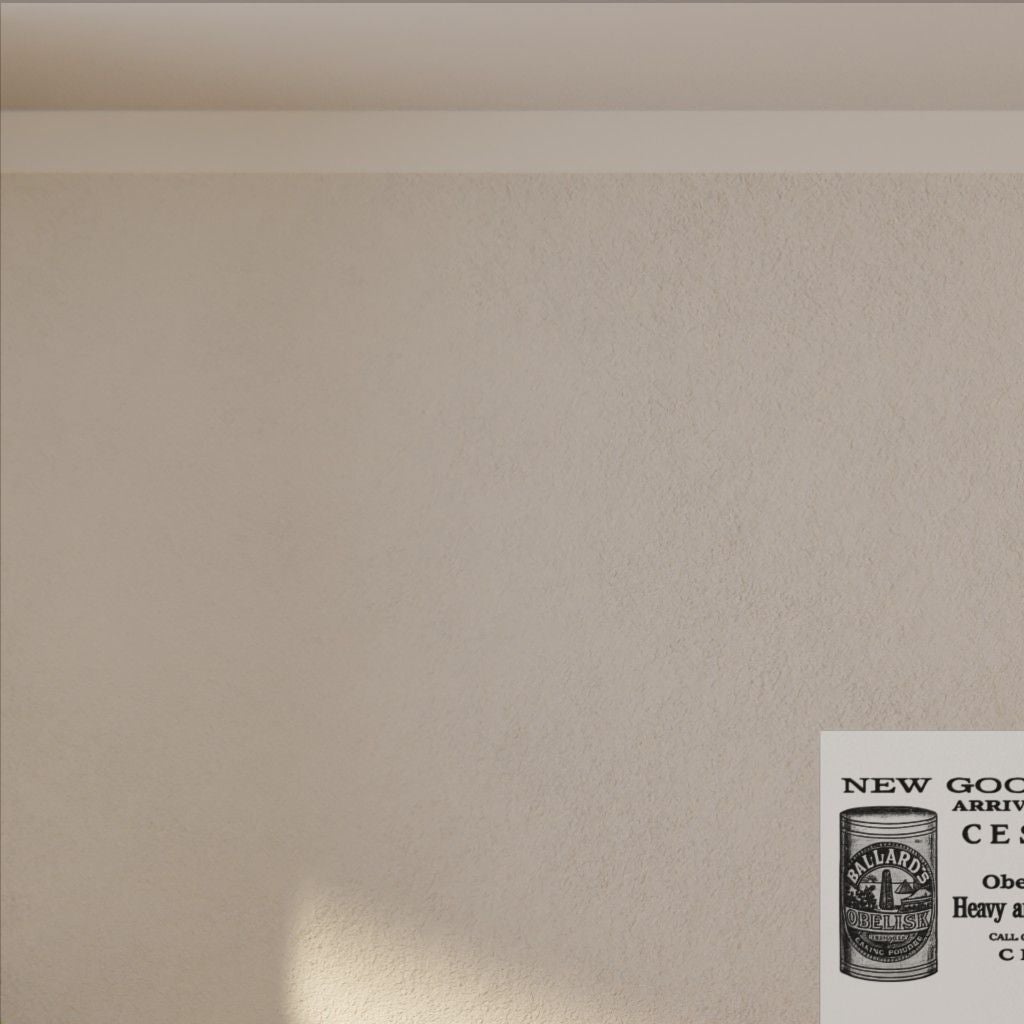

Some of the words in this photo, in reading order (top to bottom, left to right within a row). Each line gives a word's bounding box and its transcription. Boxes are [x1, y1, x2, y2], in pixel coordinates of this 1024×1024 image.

[841, 777, 933, 794] NEW
[961, 823, 982, 845] C
[989, 823, 1011, 845] E
[847, 848, 930, 884] BALLARD'S
[846, 909, 930, 931] OBELISK
[951, 895, 1008, 924] Heavy
[998, 948, 1015, 962] C
